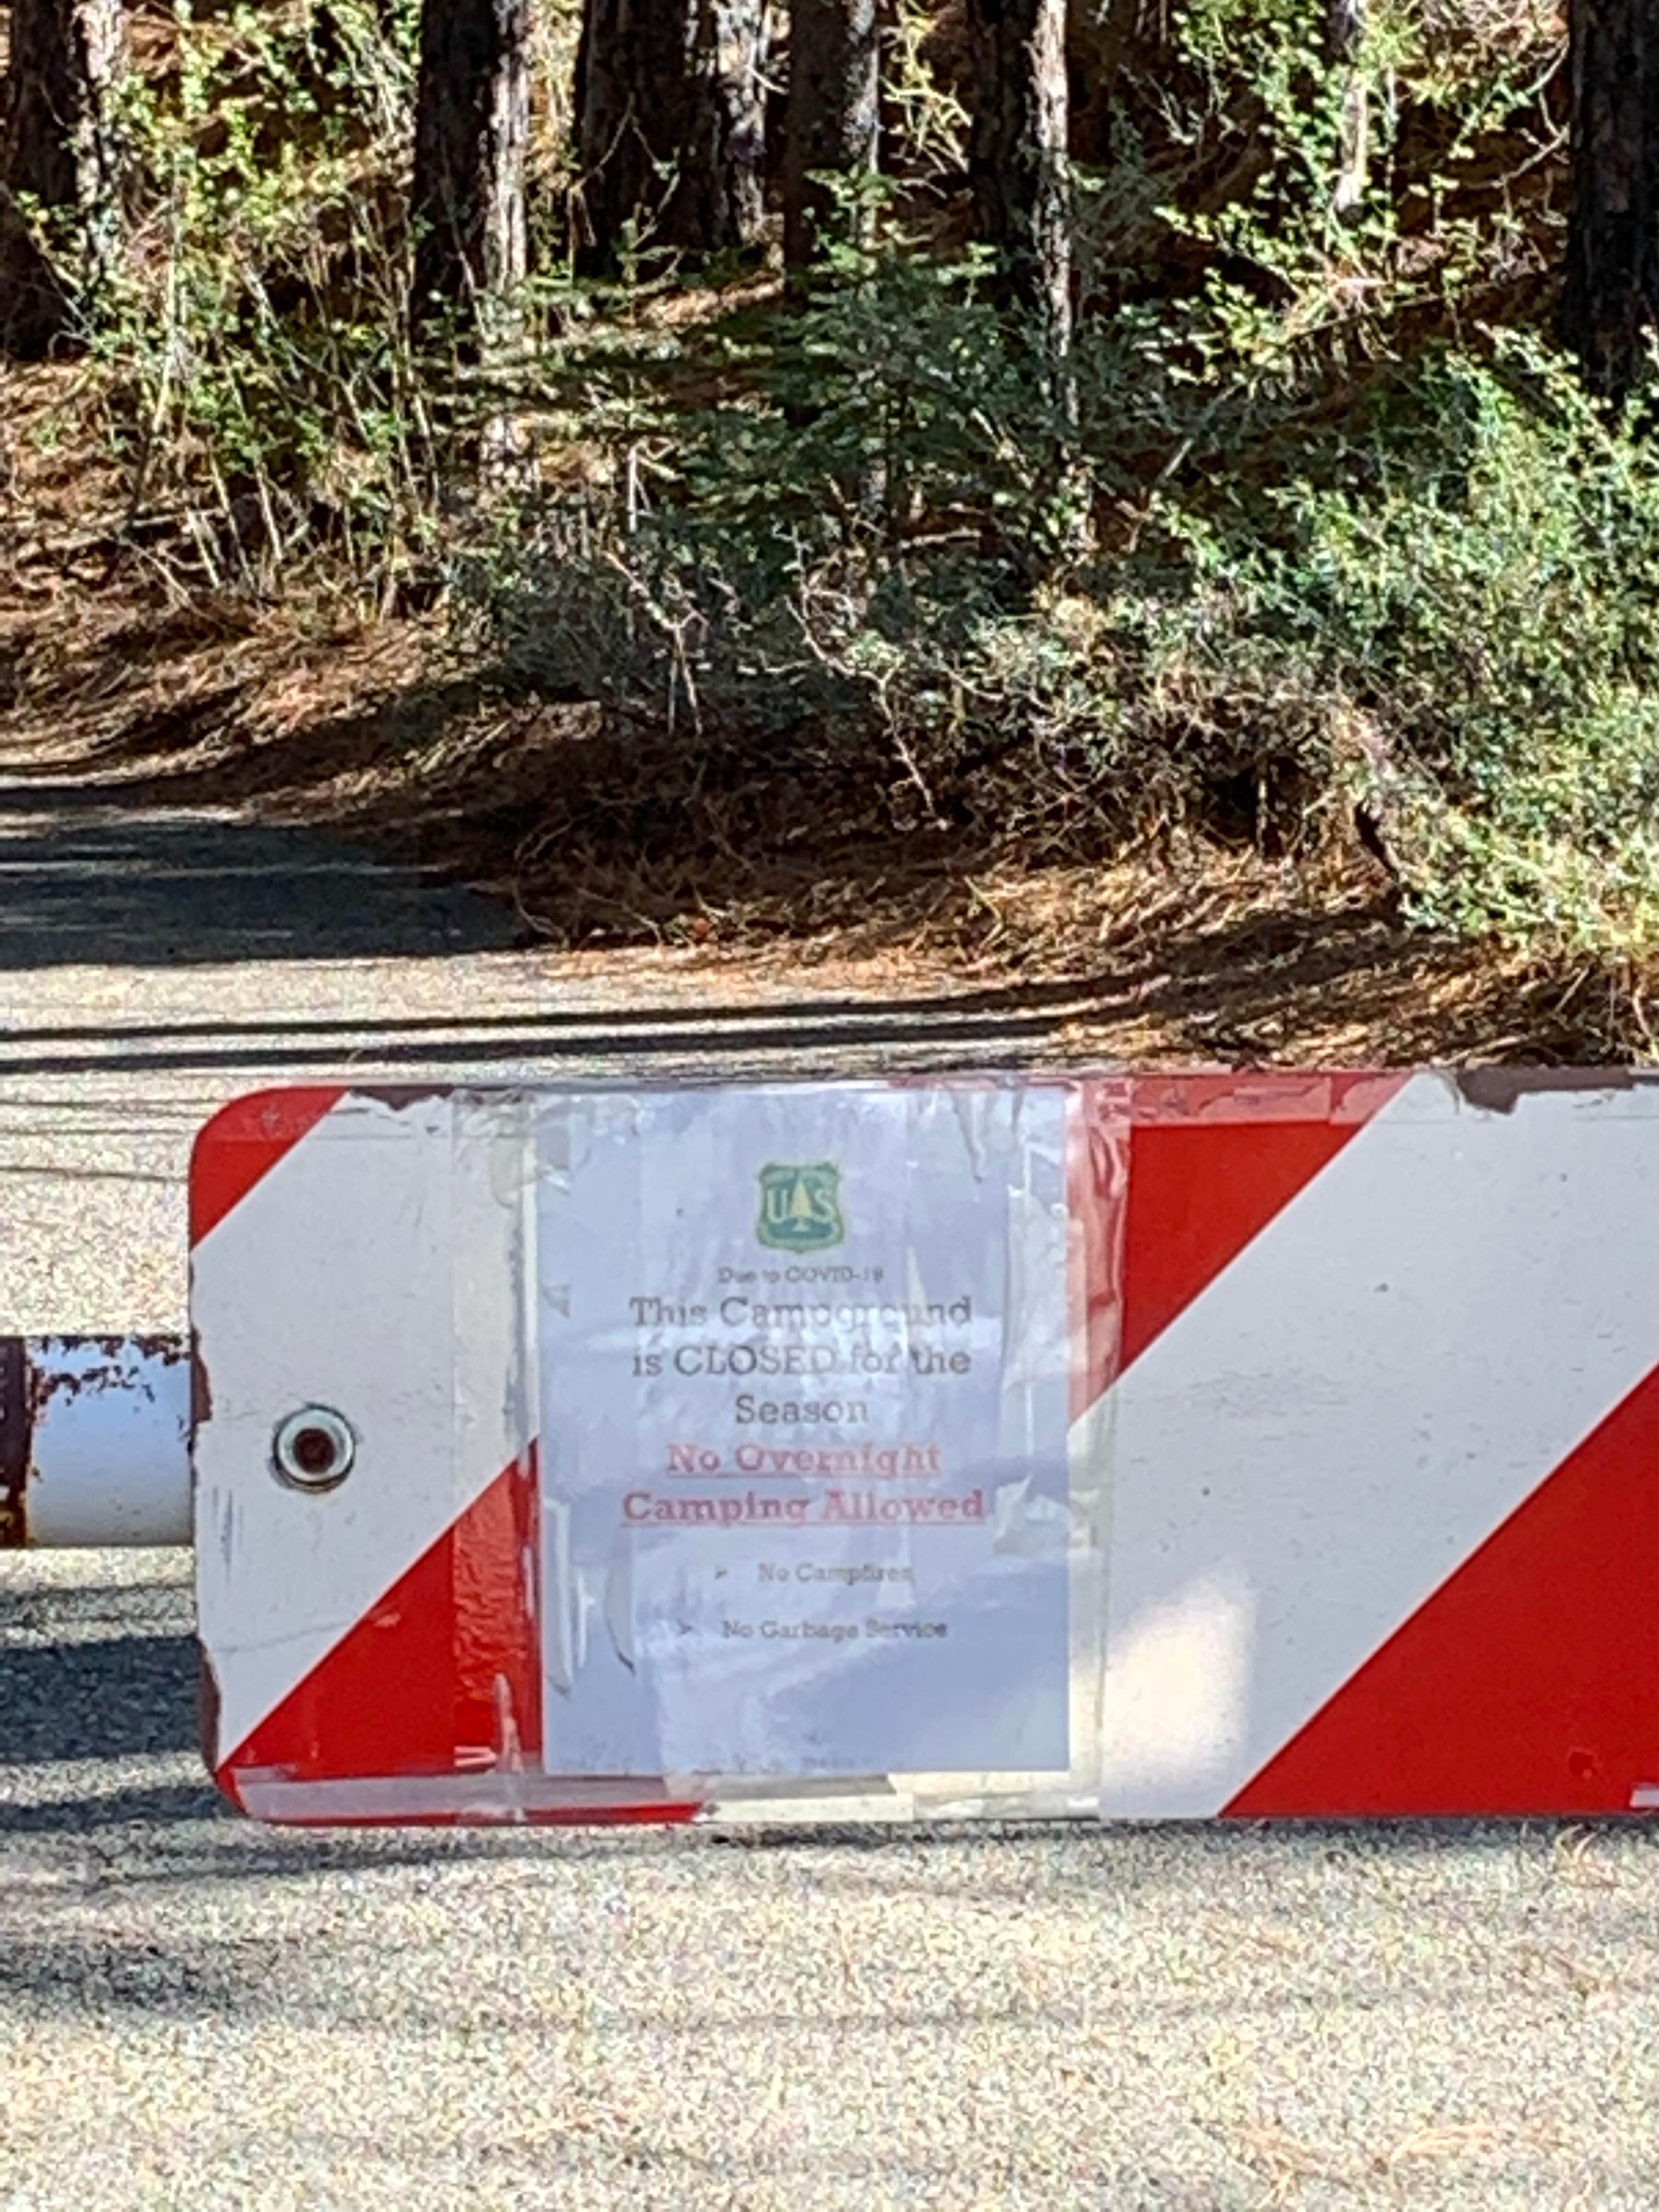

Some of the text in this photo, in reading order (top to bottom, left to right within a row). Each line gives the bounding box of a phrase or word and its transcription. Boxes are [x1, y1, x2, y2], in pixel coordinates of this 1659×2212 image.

[718, 1266, 884, 1284] Due to COVID-19
[630, 1296, 972, 1333] This Campground
[633, 1345, 972, 1378] is CLOSED for the
[735, 1393, 870, 1426] Season
[666, 1442, 941, 1477] No Overnight
[622, 1489, 986, 1523] Camping Allowed
[758, 1562, 915, 1585] No Campfires
[722, 1620, 948, 1643] No Garbage Service
